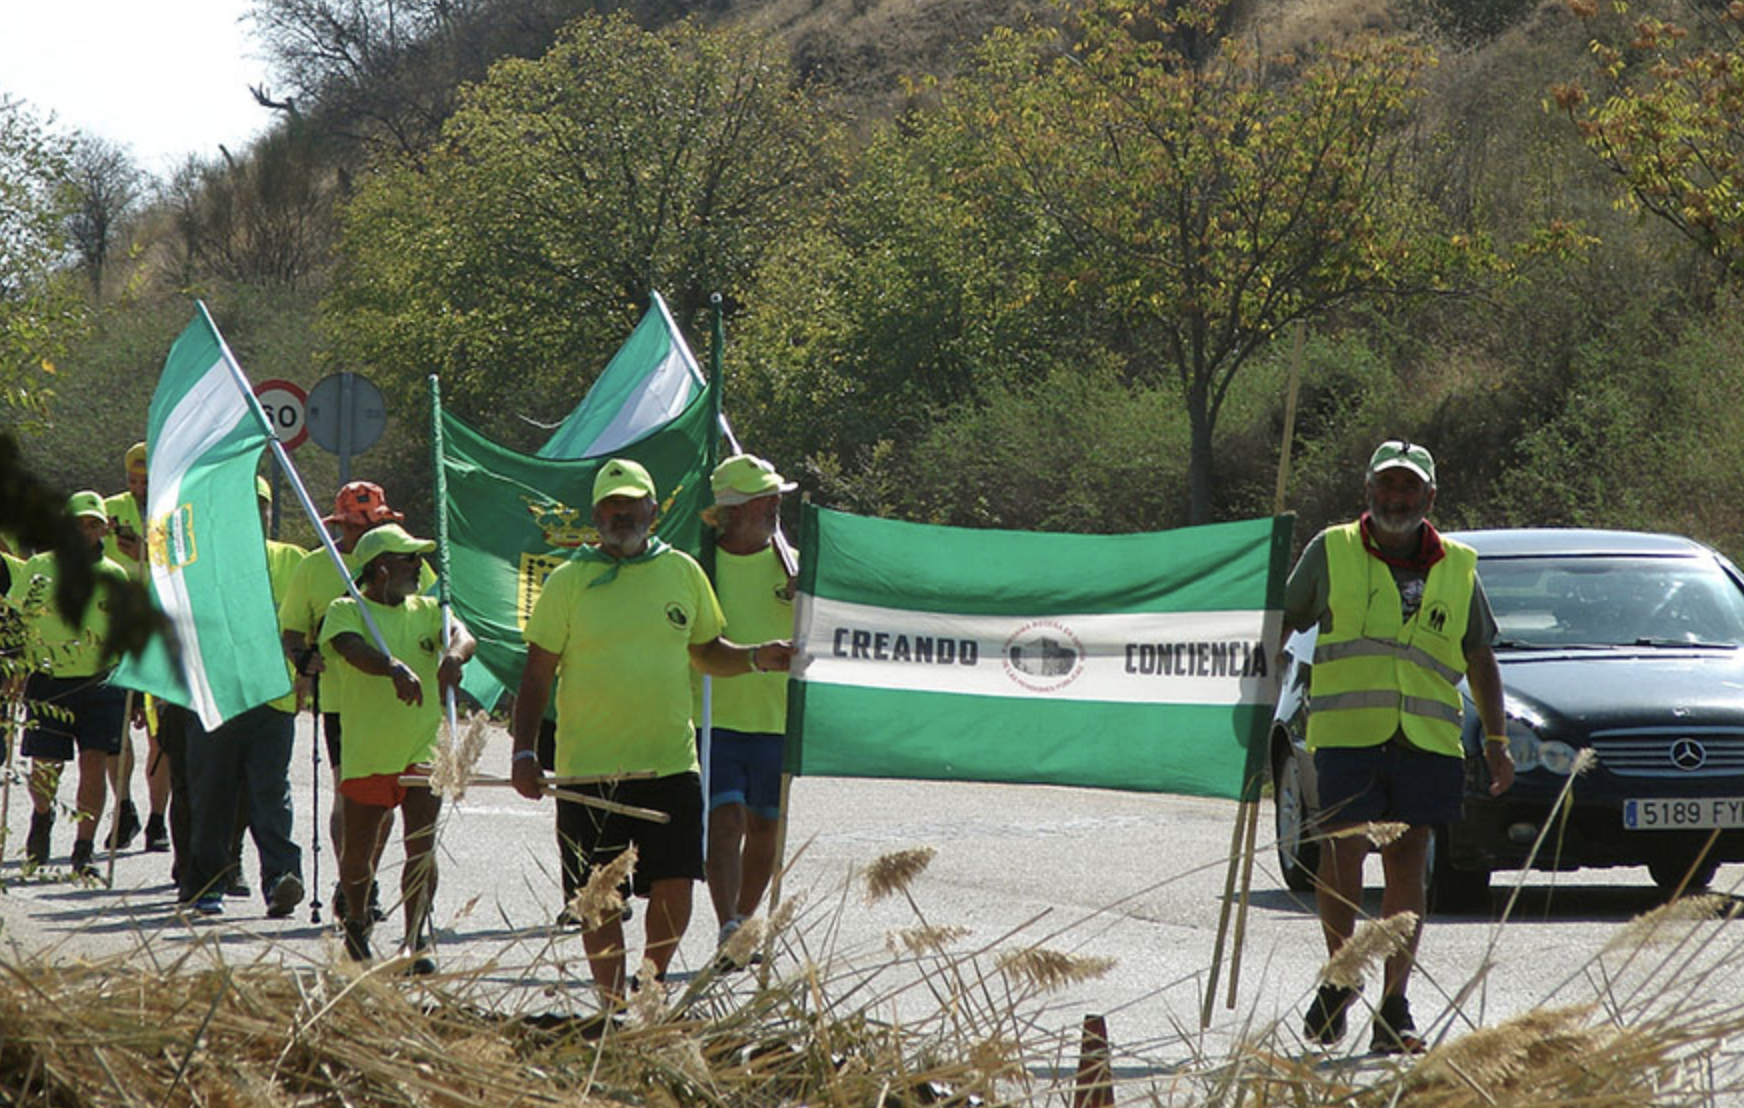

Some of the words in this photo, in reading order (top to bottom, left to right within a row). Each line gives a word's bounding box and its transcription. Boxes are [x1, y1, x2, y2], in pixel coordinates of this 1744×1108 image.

[833, 627, 979, 666] CREANDO
[1125, 641, 1268, 677] CONCIENCIA
[1643, 801, 1700, 824] 5189
[1713, 801, 1744, 824] FY
